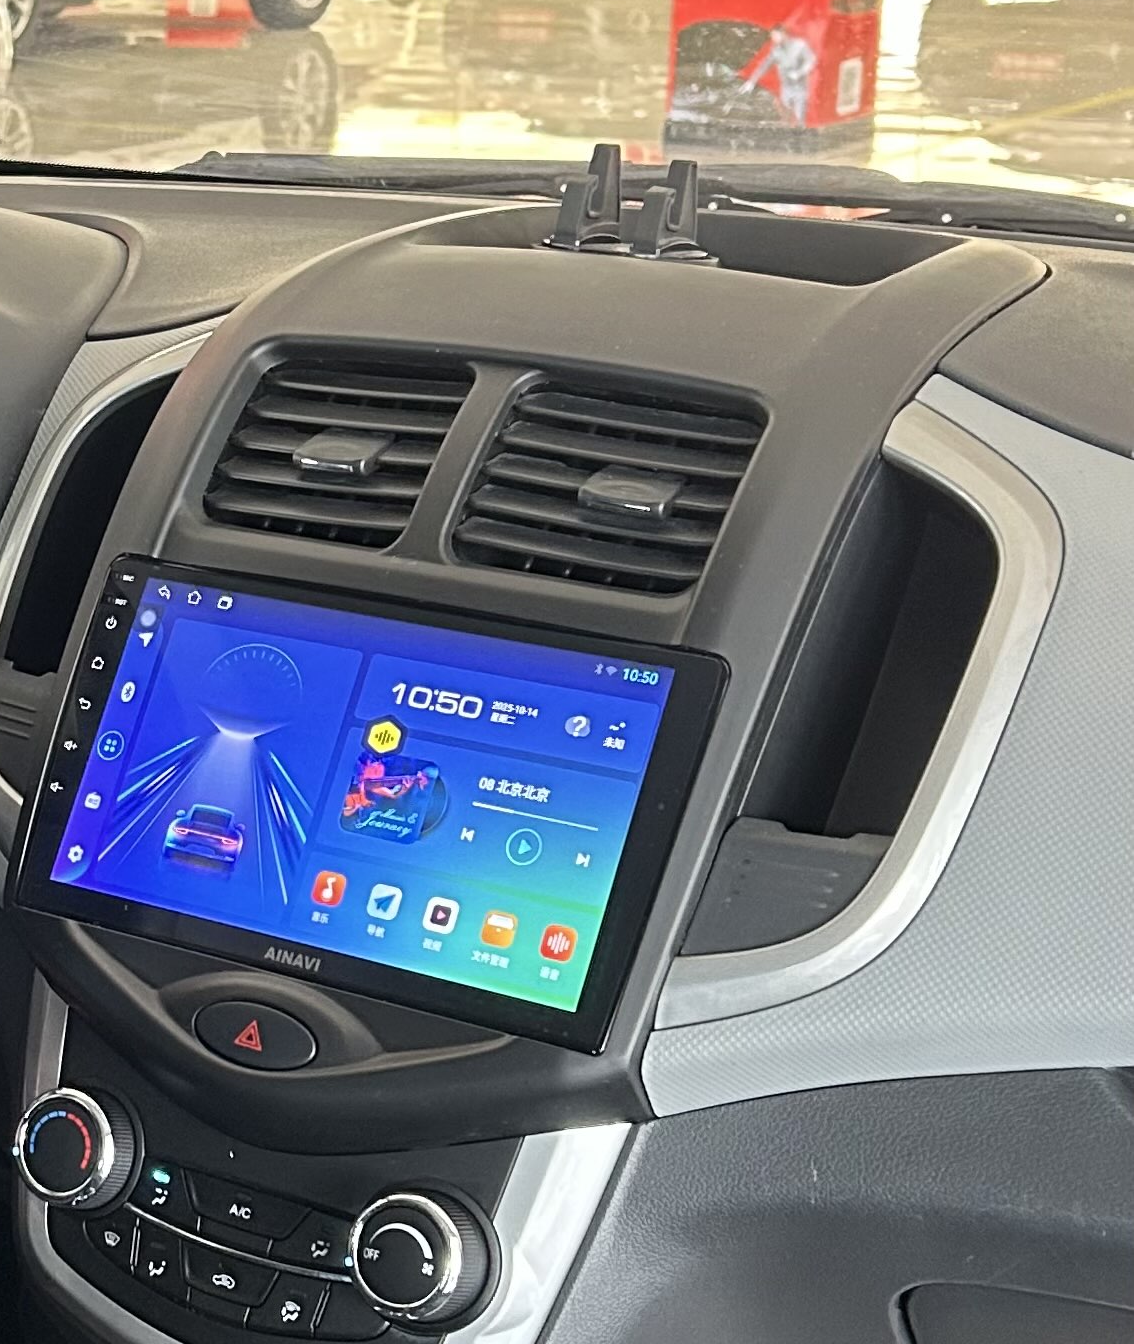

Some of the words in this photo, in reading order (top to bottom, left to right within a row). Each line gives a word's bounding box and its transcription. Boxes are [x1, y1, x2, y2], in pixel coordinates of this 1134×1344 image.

[621, 666, 660, 687] 10:50
[391, 682, 484, 720] 10:50
[263, 945, 323, 973] AINAVI
[228, 1202, 253, 1220] A/C
[362, 1246, 381, 1261] OFF
